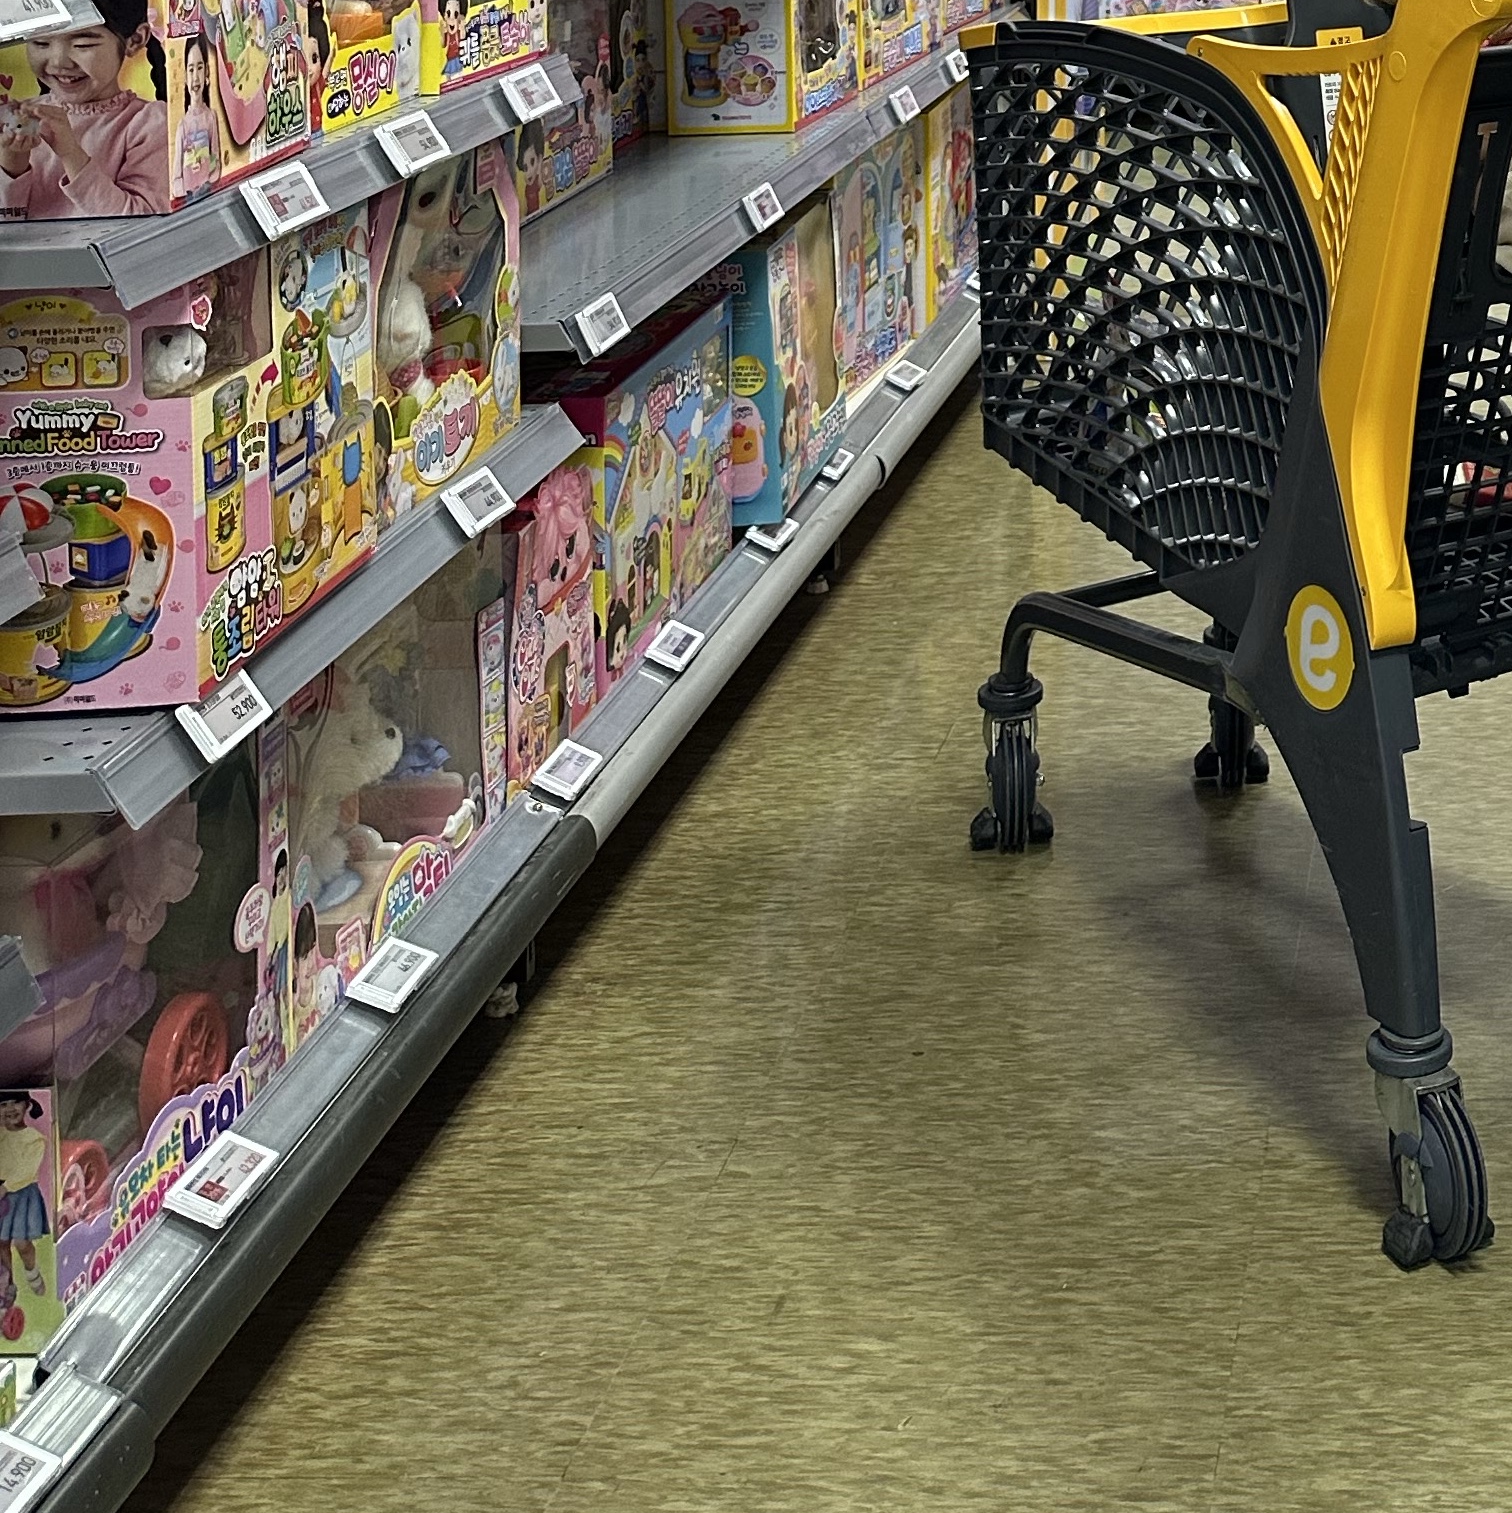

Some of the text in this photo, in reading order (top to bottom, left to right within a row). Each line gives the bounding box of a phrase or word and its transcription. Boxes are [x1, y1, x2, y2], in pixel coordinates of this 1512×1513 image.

[348, 47, 397, 117] 몽실이
[15, 408, 96, 433] Yummy
[46, 432, 96, 452] Food
[97, 430, 160, 451] Tower
[1300, 604, 1341, 693] e
[231, 694, 258, 720] 52,900
